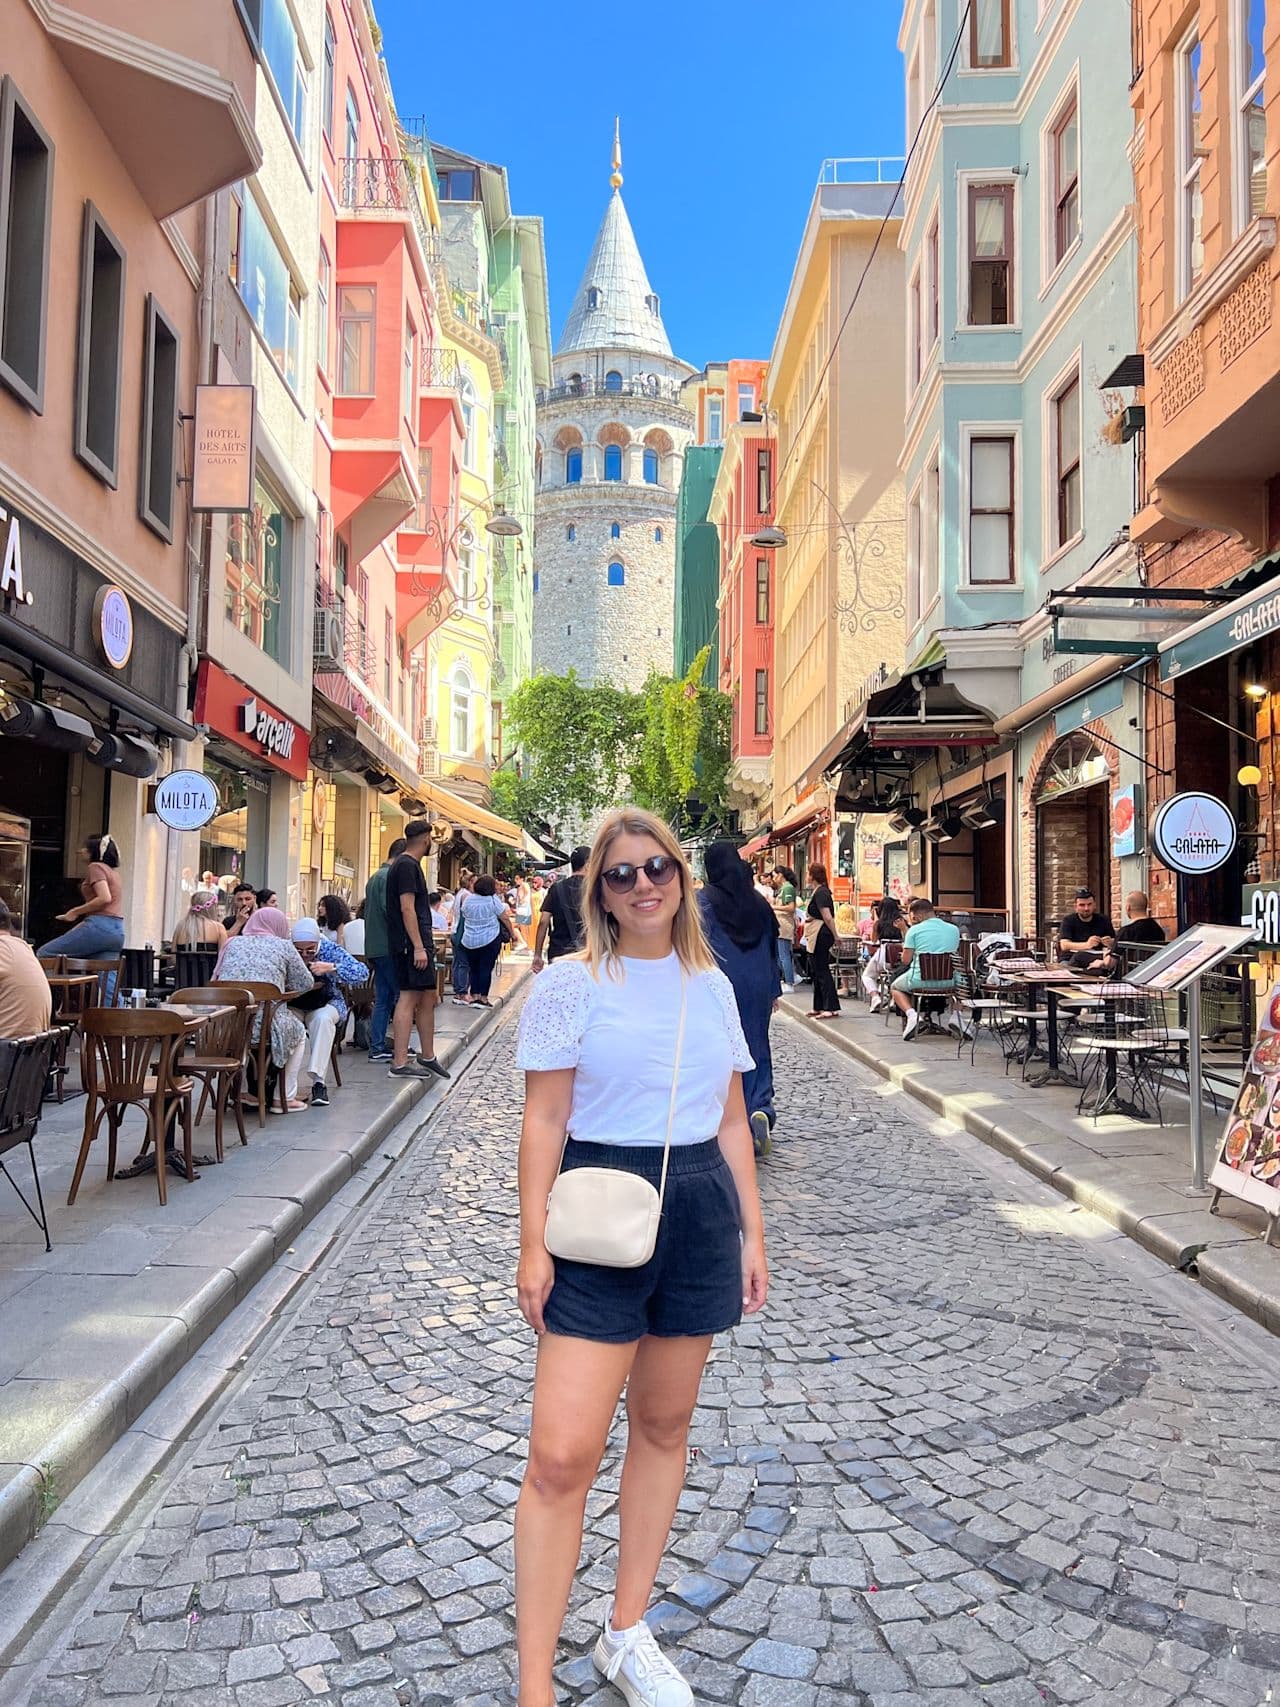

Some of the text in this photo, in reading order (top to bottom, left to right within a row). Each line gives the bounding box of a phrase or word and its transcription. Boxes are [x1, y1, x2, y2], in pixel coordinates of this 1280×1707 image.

[206, 429, 241, 439] HOTEL
[200, 442, 247, 452] DES ARTS
[207, 457, 238, 465] GALATA
[256, 710, 295, 760] arçelik
[161, 791, 211, 810] MILOTA.
[1174, 837, 1220, 855] GALATA
